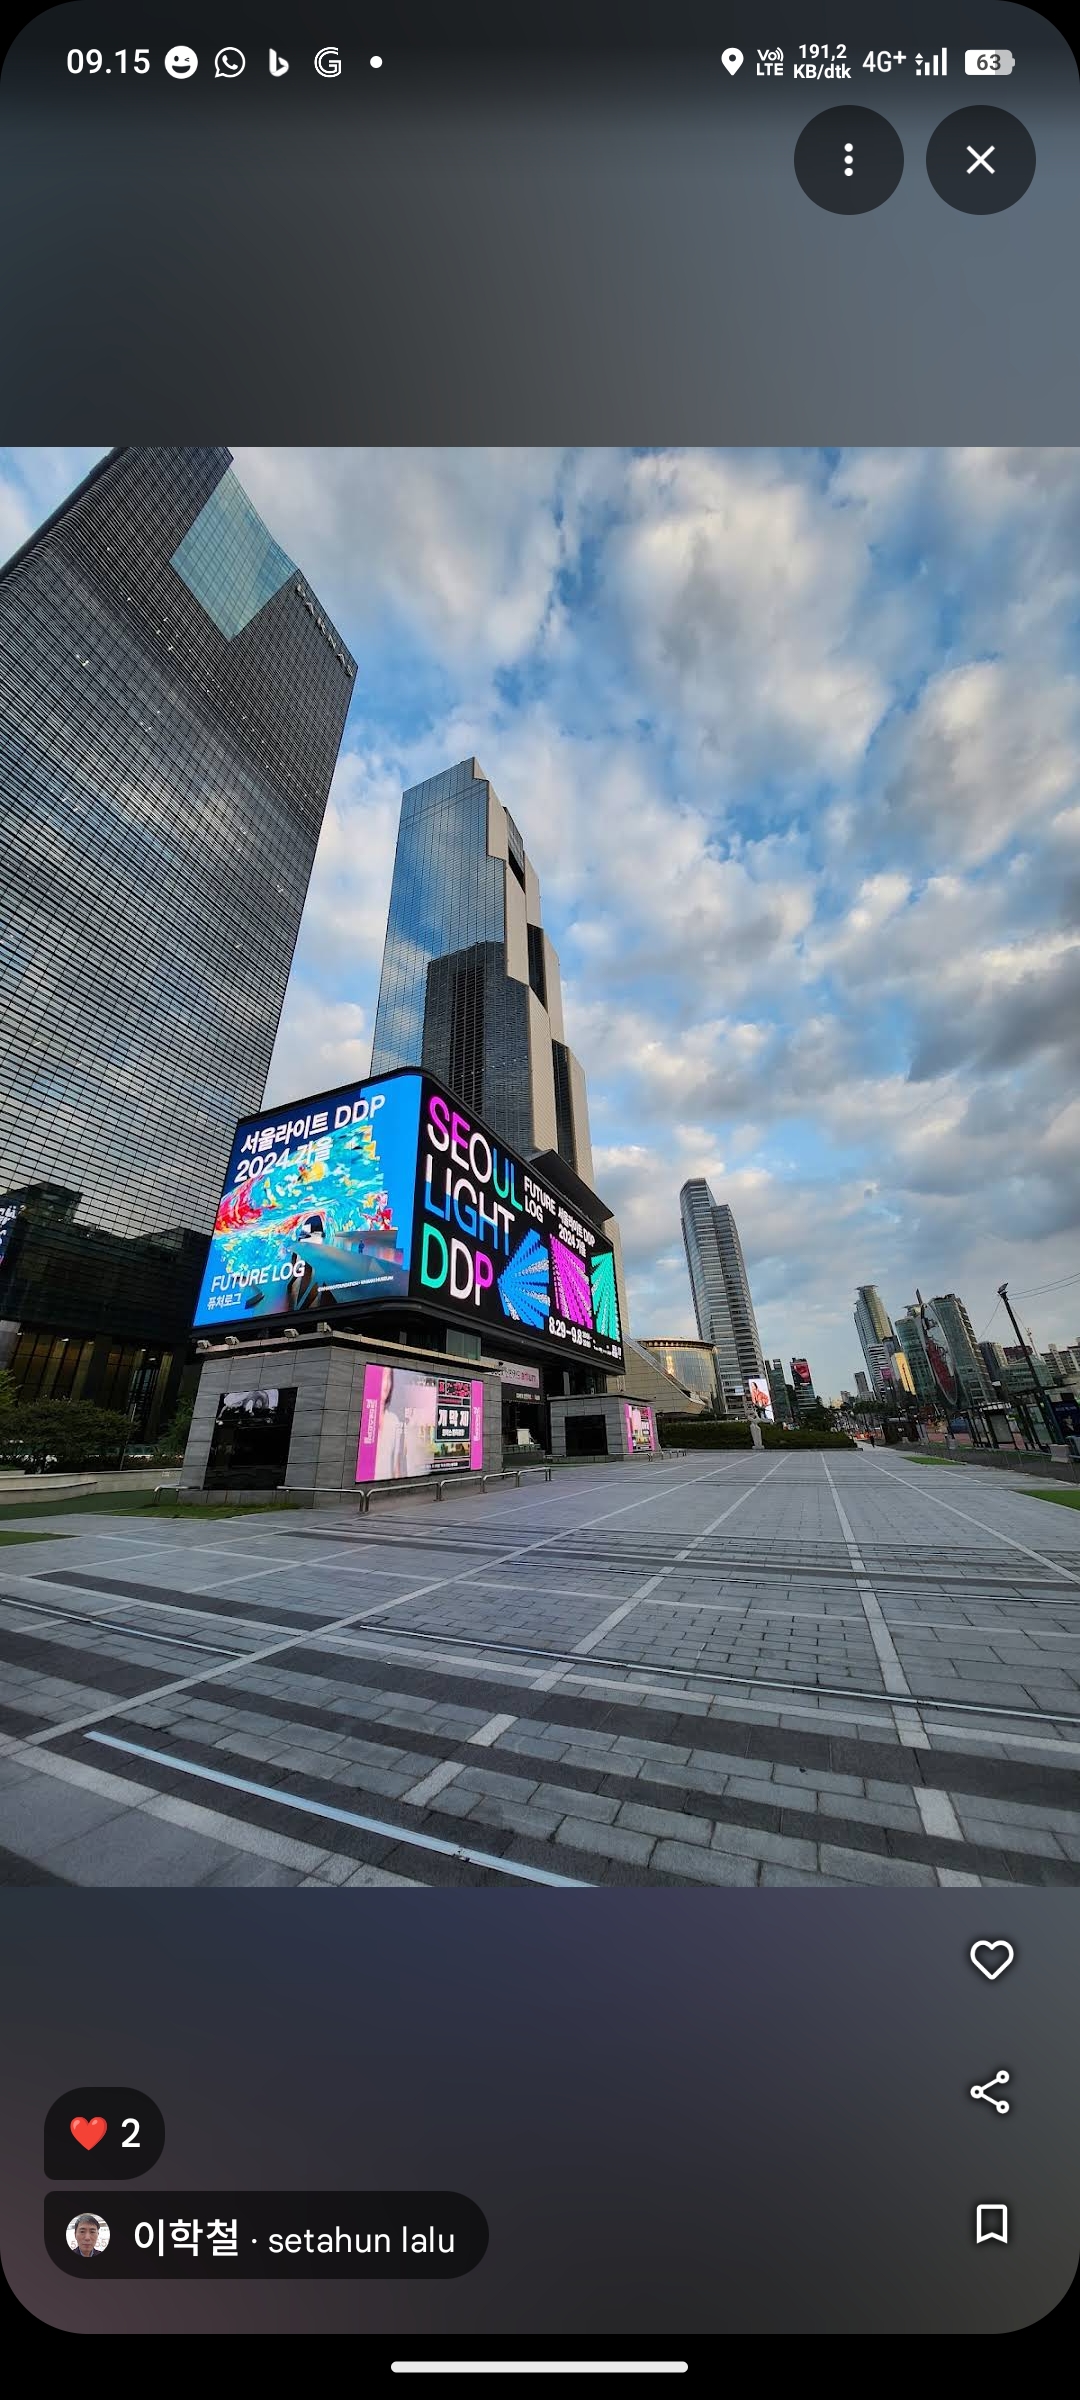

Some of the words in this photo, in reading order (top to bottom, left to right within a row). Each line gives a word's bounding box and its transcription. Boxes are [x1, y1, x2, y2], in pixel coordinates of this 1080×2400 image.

[241, 1111, 329, 1154] 서울라이트
[334, 1094, 386, 1128] DDP
[234, 1151, 290, 1183] 2024
[295, 1136, 333, 1164] 가을
[427, 1096, 523, 1212] SEOUL
[425, 1154, 515, 1255] LIGHT
[524, 1175, 556, 1216] FUTURE
[524, 1198, 544, 1224] LOG
[558, 1223, 576, 1248] 2024
[583, 1227, 596, 1247] DDP
[211, 1264, 271, 1292] FUTURE
[272, 1260, 306, 1280] LOG
[420, 1222, 494, 1306] DDP
[207, 1292, 241, 1310] 퓨처로그
